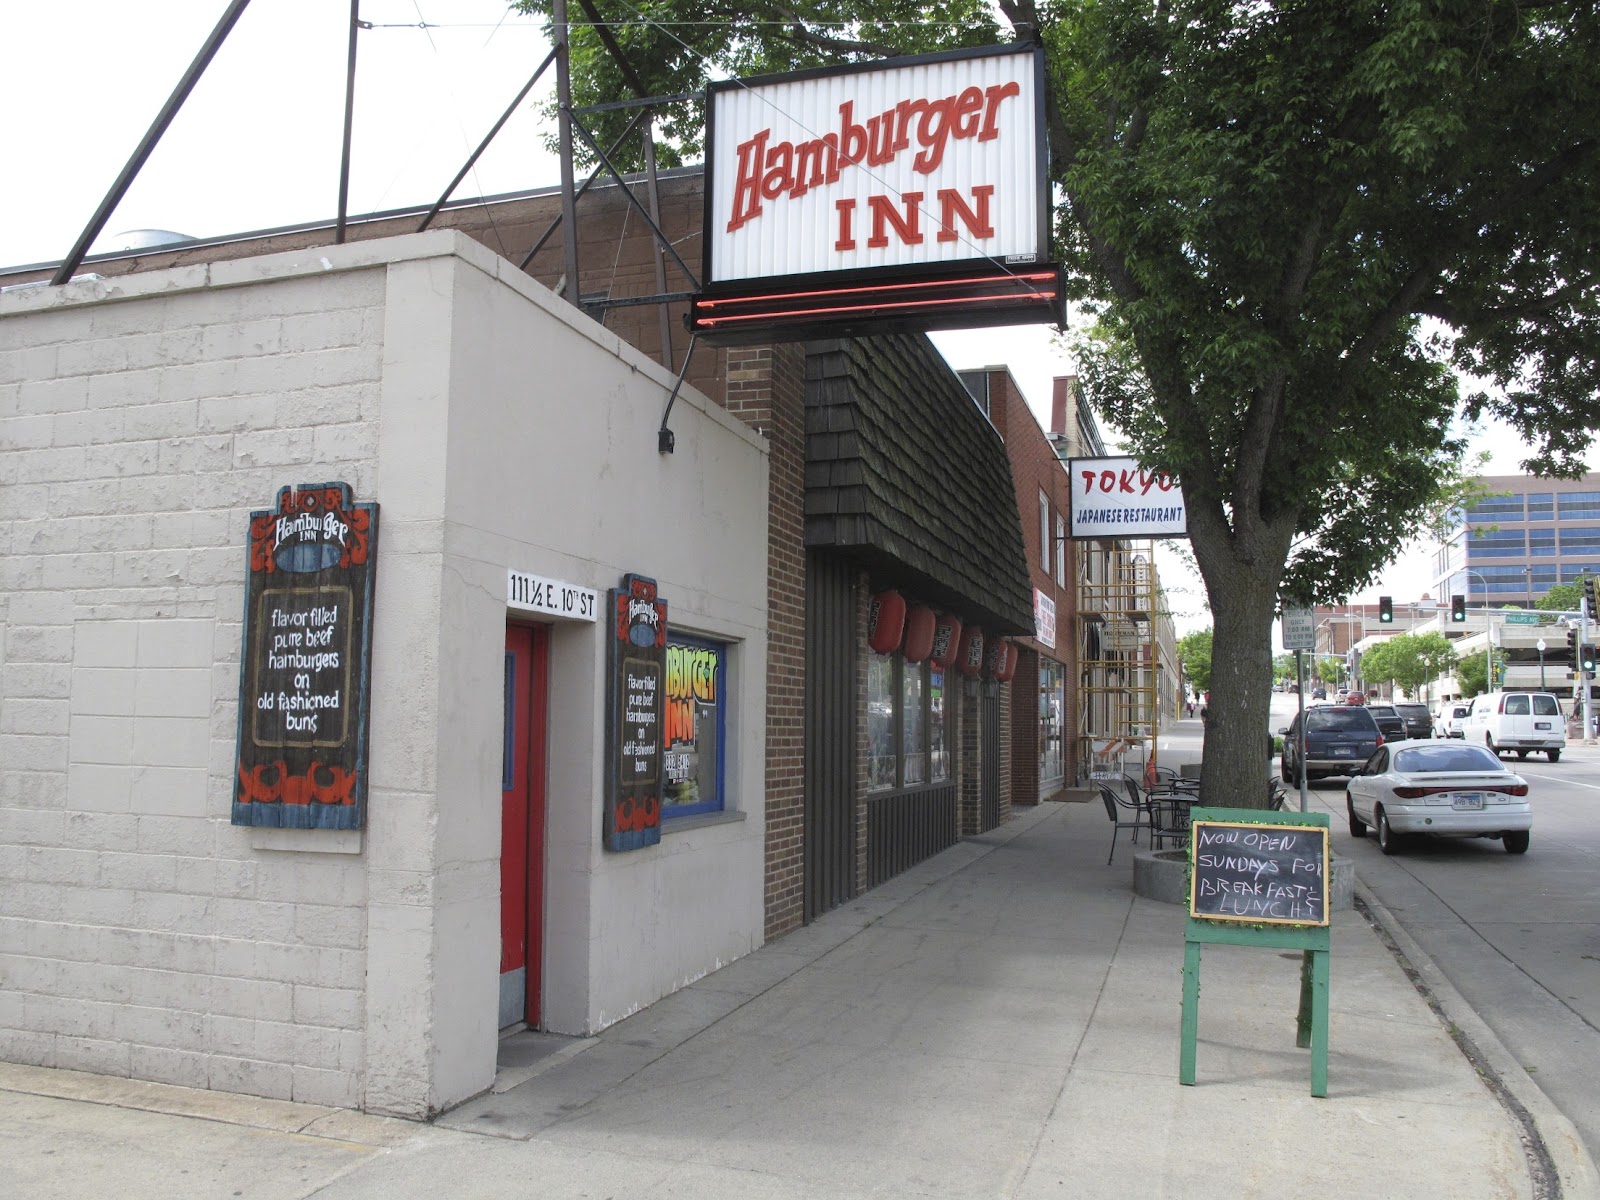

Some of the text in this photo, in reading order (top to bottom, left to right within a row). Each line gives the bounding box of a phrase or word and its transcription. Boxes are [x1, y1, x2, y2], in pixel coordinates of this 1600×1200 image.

[726, 81, 1020, 234] Hamburger
[834, 184, 995, 252] INN
[1081, 468, 1174, 496] TOKYO
[1076, 506, 1183, 524] JAPANESE RESTAURANT
[272, 511, 349, 552] Hamburger
[299, 532, 318, 543] INN
[546, 584, 558, 609] E.
[580, 591, 595, 617] ST
[271, 606, 337, 627] flavor filled
[273, 626, 333, 652] pure beef
[268, 649, 340, 672] hamburgers
[294, 674, 310, 688] on
[628, 674, 656, 691] flavor filled
[257, 690, 339, 714] old fashioned
[643, 692, 654, 706] beef
[286, 712, 318, 733] buns
[638, 726, 645, 739] on
[664, 697, 693, 748] INN
[623, 744, 632, 755] old
[635, 758, 648, 772] buns
[1199, 831, 1296, 851] NOW OPEN
[1199, 854, 1322, 880] SUNDAYS FOR
[1200, 878, 1307, 898] BREAKFAST
[1219, 893, 1301, 918] LUNCH
